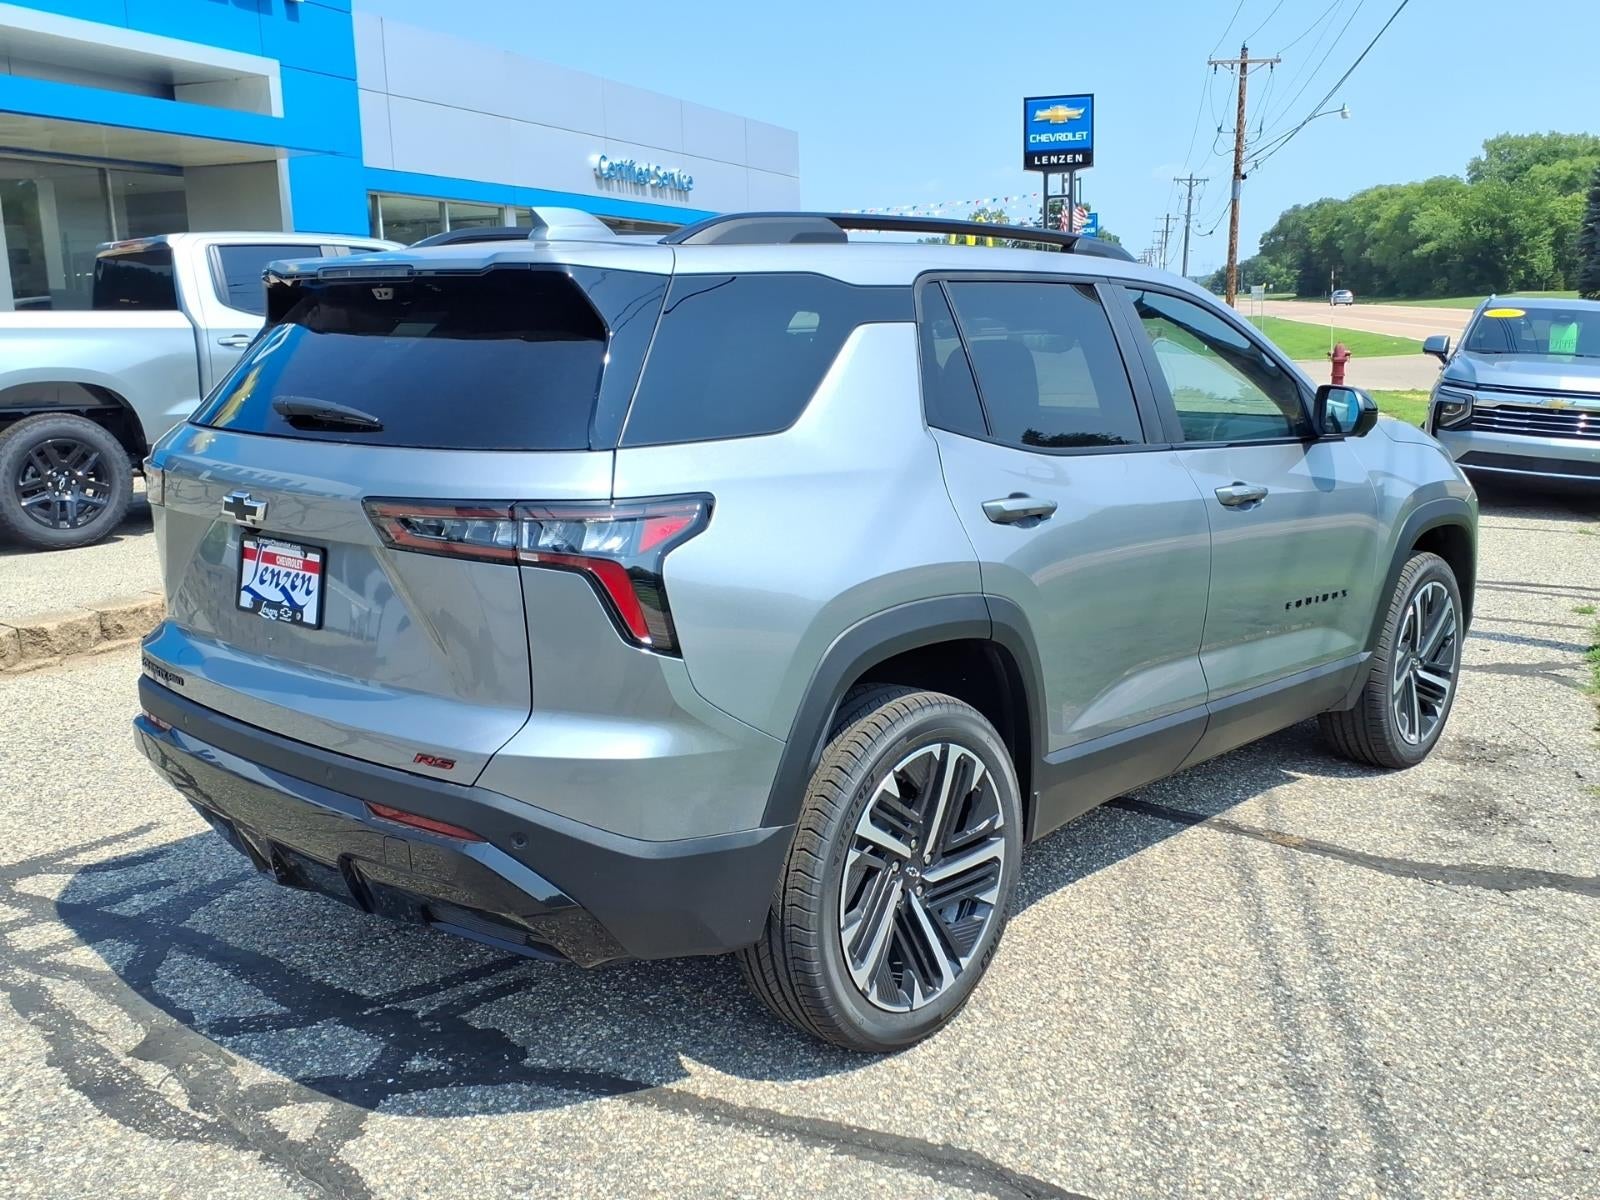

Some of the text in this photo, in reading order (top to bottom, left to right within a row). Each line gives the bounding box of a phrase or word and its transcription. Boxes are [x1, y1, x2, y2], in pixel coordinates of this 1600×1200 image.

[1029, 131, 1088, 143] CHEVROLET
[1034, 154, 1083, 165] LENZEN
[598, 154, 694, 193] Certified Service
[275, 555, 304, 570] CHEVROLET
[241, 543, 317, 609] Lenzen
[413, 753, 456, 770] RS
